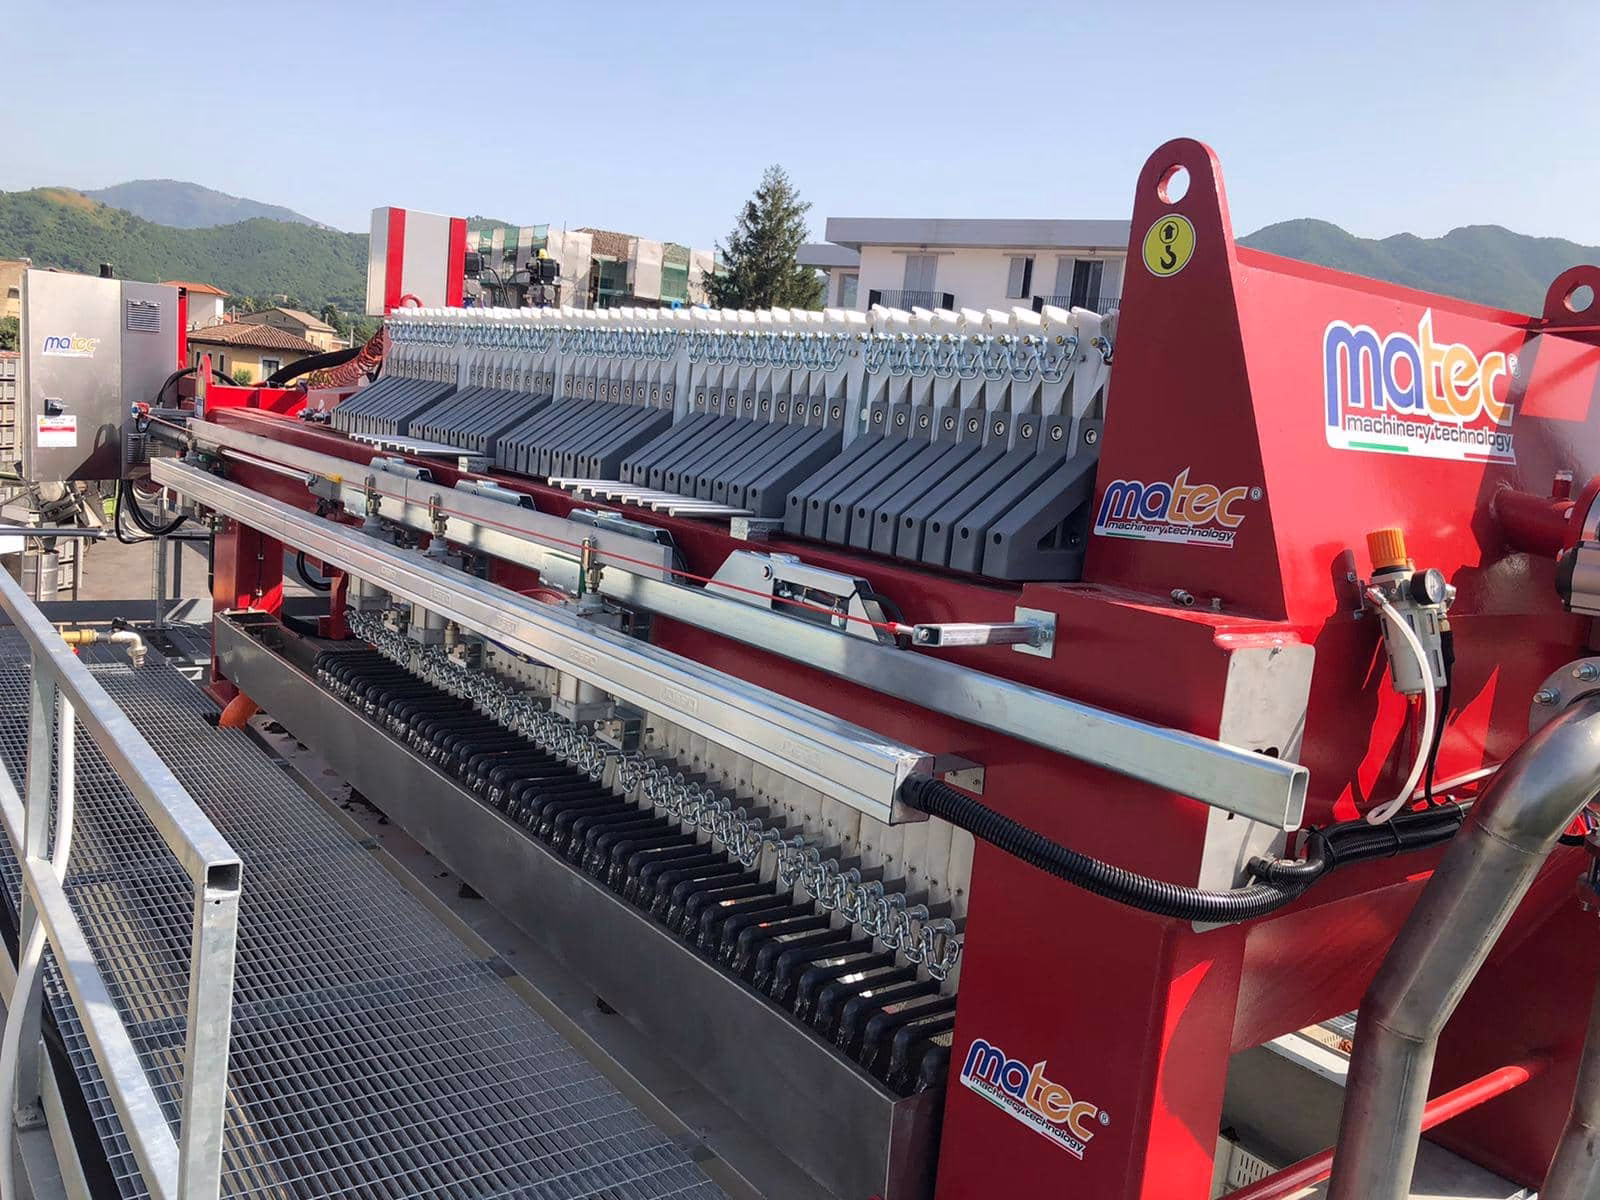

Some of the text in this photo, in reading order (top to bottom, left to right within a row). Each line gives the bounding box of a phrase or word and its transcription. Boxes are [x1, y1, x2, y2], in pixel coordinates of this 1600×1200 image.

[1324, 309, 1515, 427] matec
[1347, 416, 1512, 452] machinery technology
[1096, 467, 1249, 528] matec
[1109, 521, 1234, 541] machinery technology
[962, 1039, 1098, 1142] matec
[1025, 1108, 1085, 1152] technology
